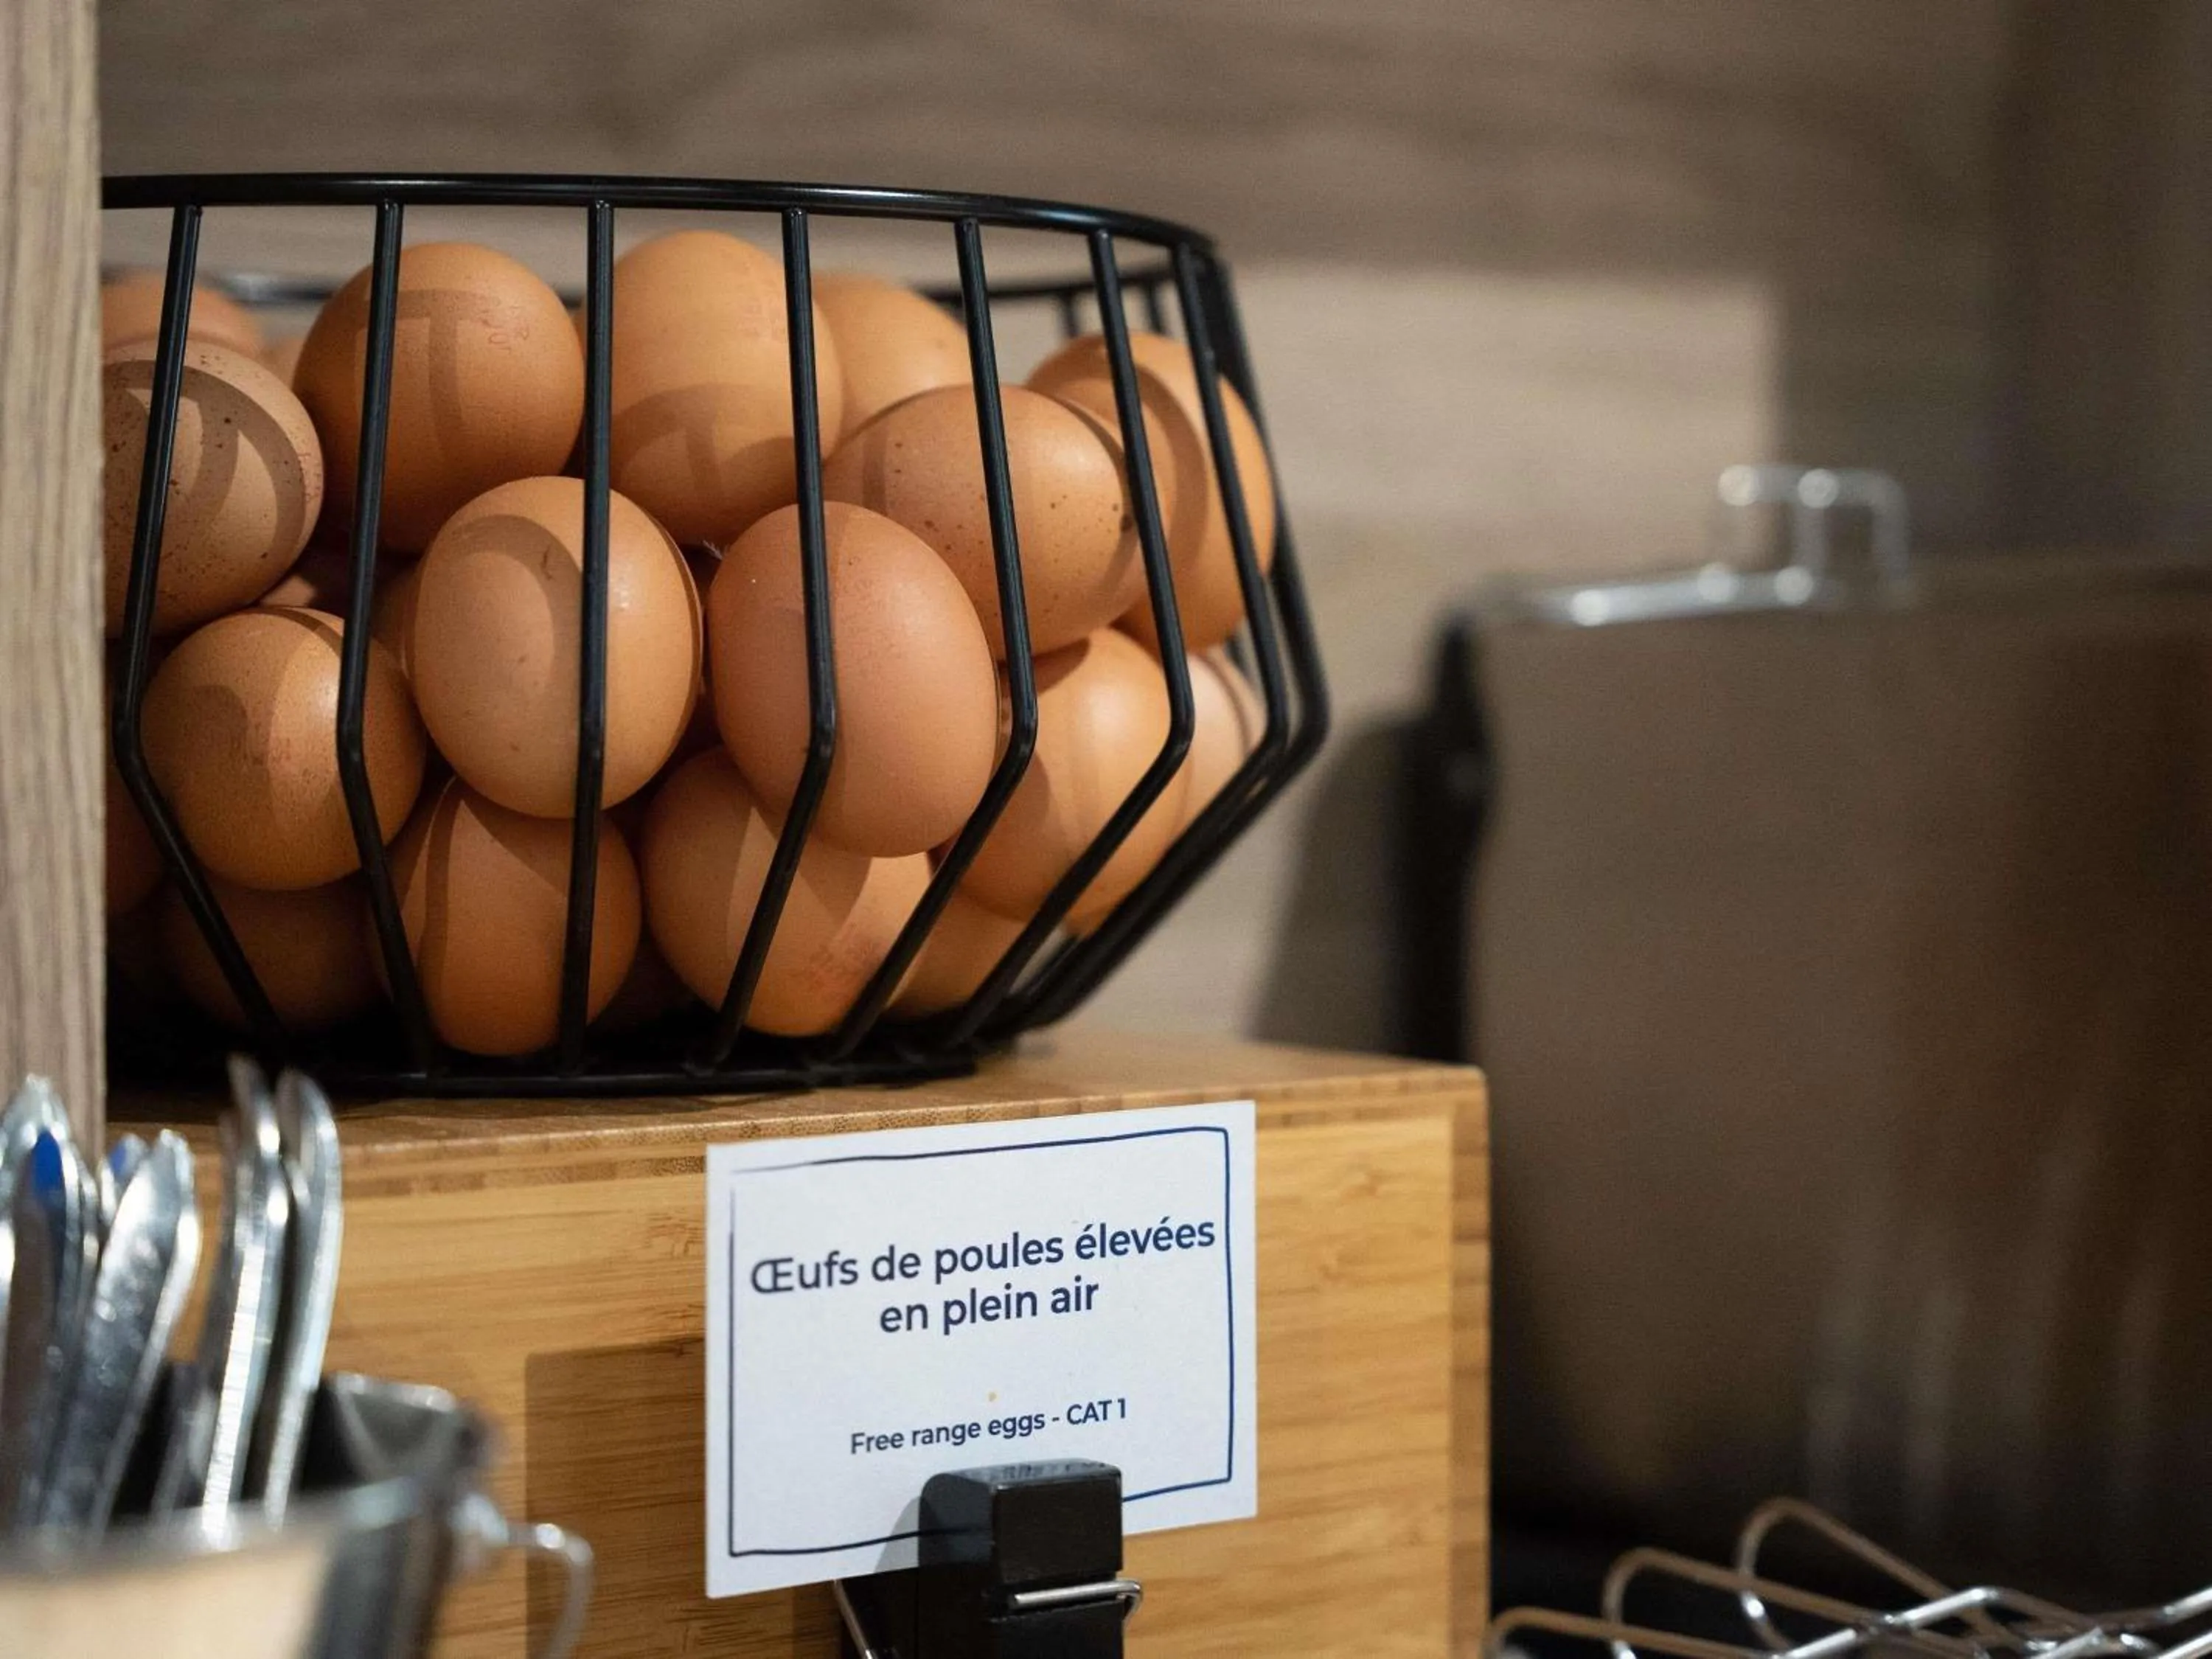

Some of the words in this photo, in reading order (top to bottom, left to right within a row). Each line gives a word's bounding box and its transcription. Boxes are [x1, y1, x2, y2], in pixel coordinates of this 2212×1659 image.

[750, 1249, 860, 1295] Œufs
[870, 1244, 922, 1283] de
[934, 1231, 1065, 1286] poules
[1074, 1215, 1217, 1261] élevées
[879, 1303, 929, 1334] en
[942, 1281, 1038, 1337] plein
[1050, 1273, 1100, 1315] air
[850, 1431, 905, 1455] Free
[911, 1421, 982, 1447] range
[987, 1413, 1046, 1441] eggs
[1065, 1399, 1113, 1426] CAT
[1116, 1397, 1127, 1420] 1
